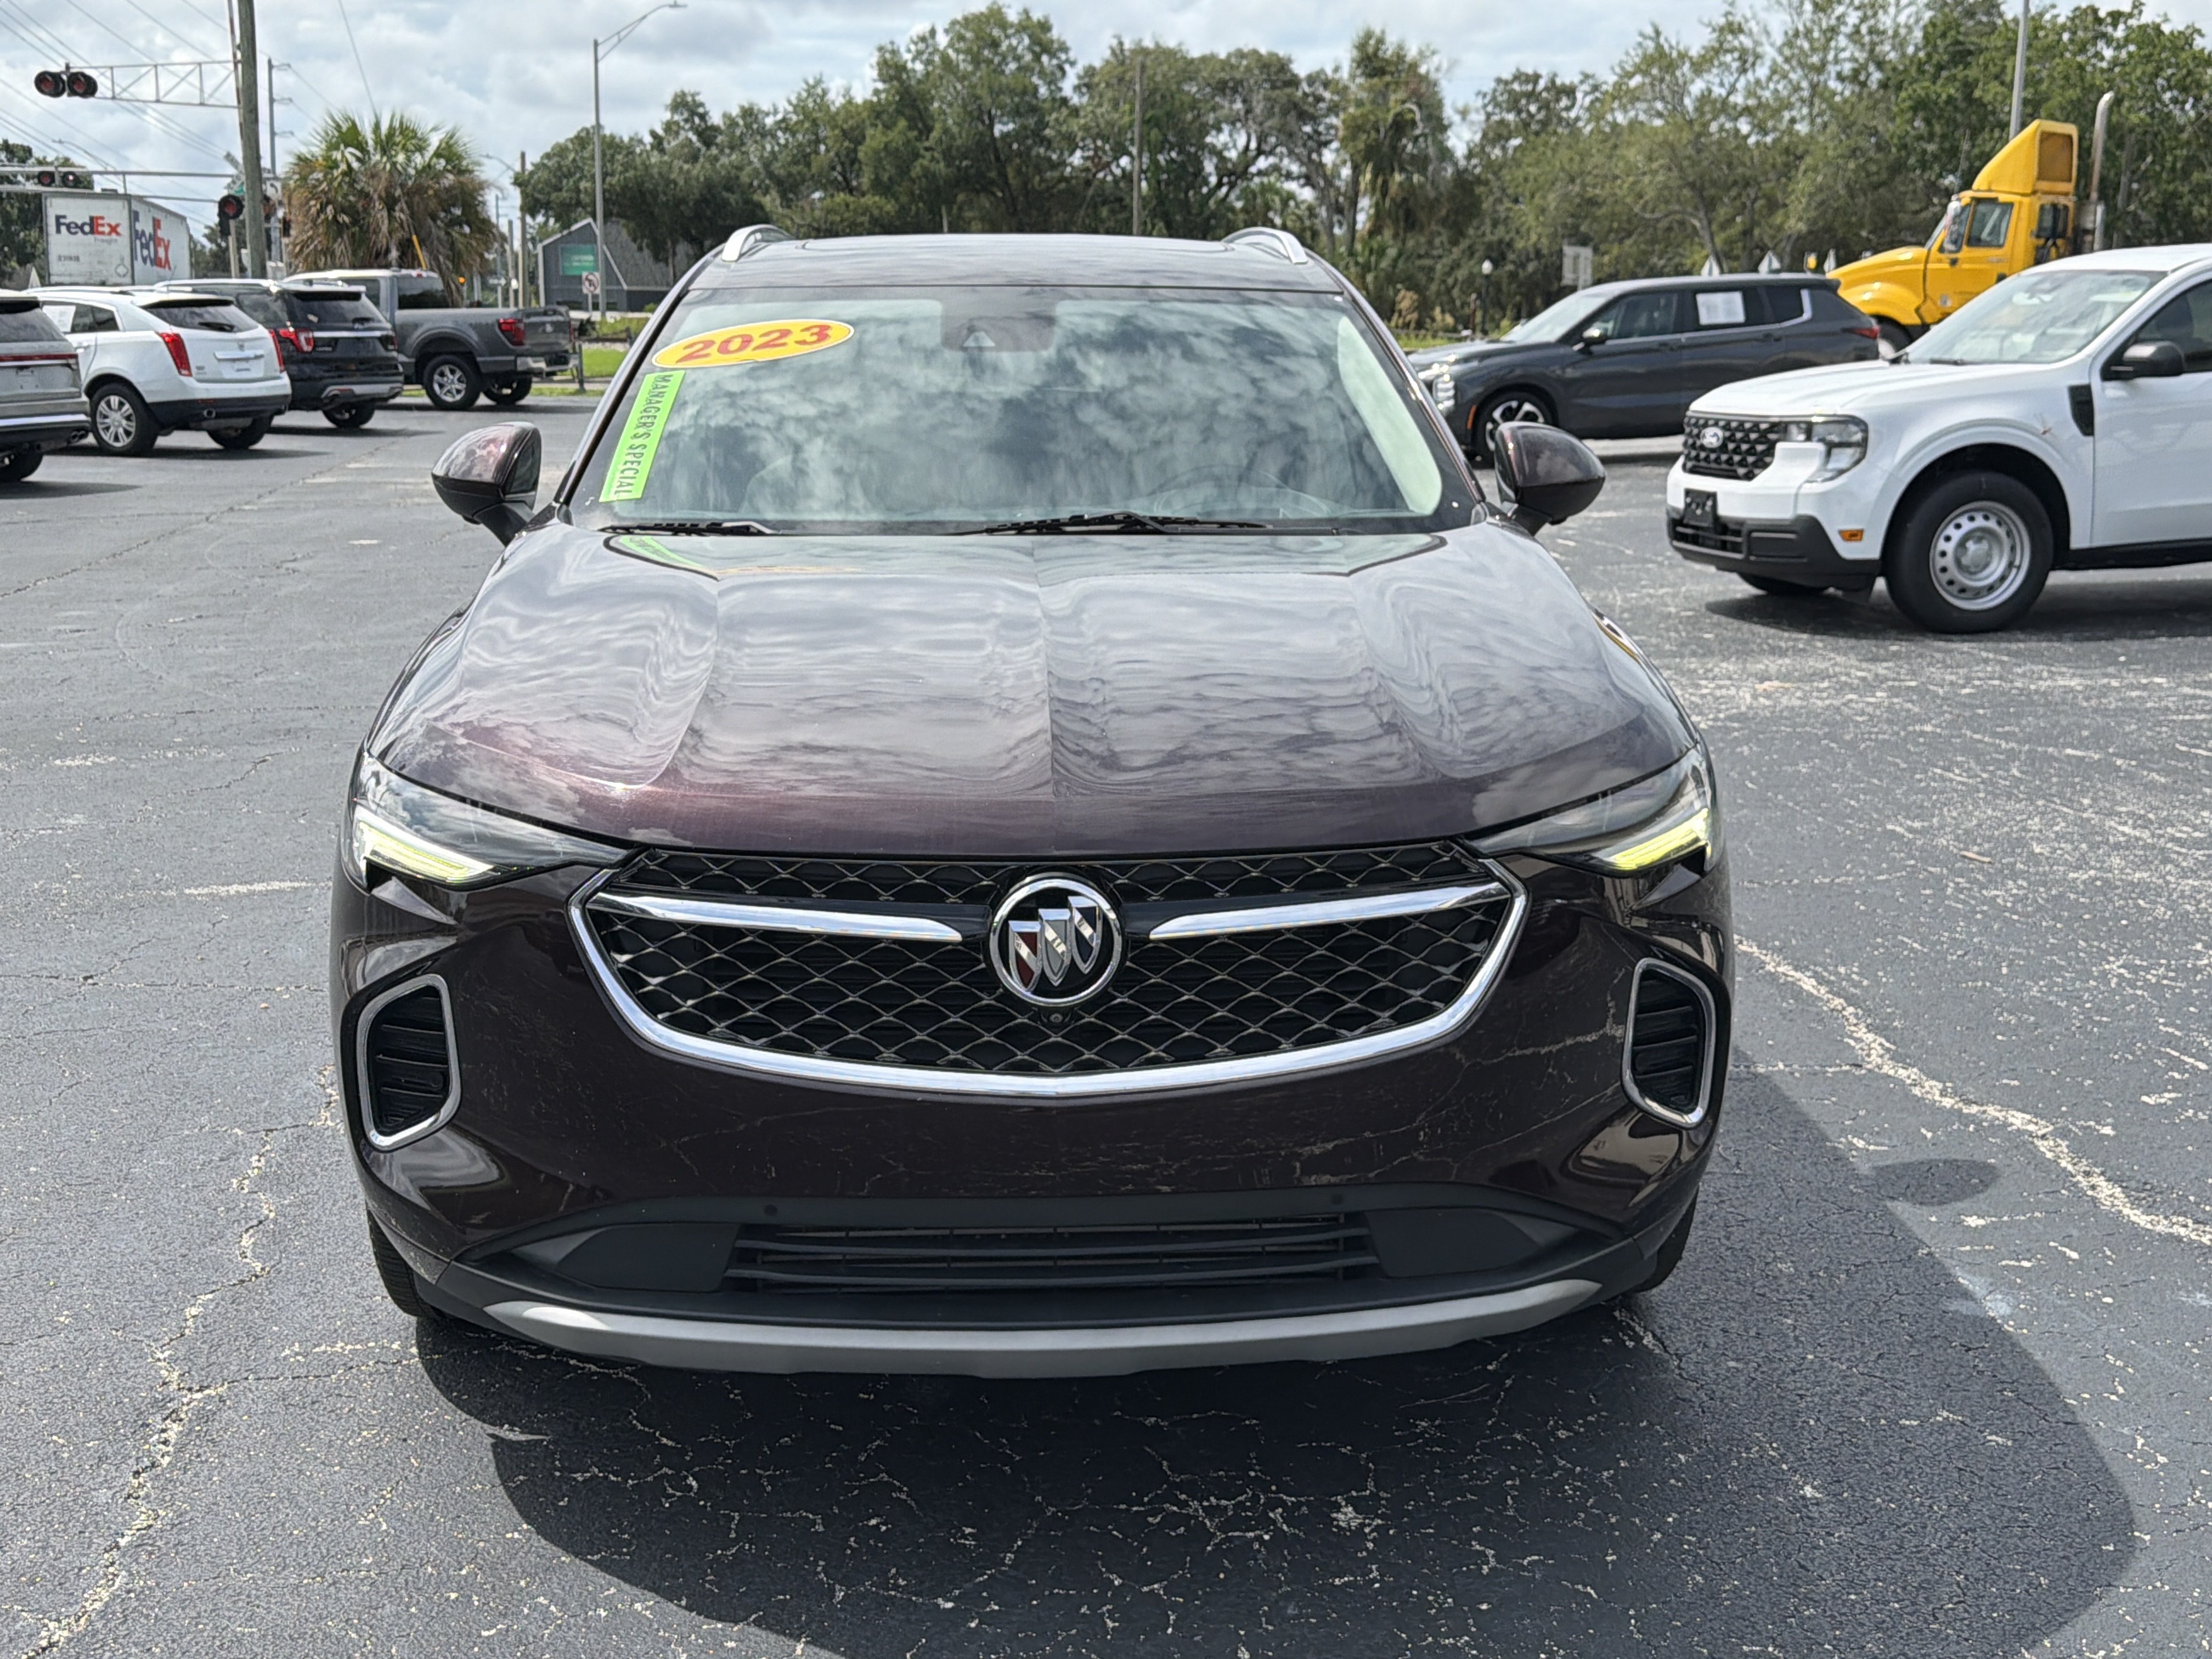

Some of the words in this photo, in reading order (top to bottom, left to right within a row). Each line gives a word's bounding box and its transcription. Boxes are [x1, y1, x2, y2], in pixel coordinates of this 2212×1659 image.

[55, 215, 122, 236] FedEx
[133, 210, 171, 271] FedEx
[675, 324, 833, 364] 2023
[631, 374, 674, 439] MANAGER'S
[614, 444, 647, 495] SPECIAL
